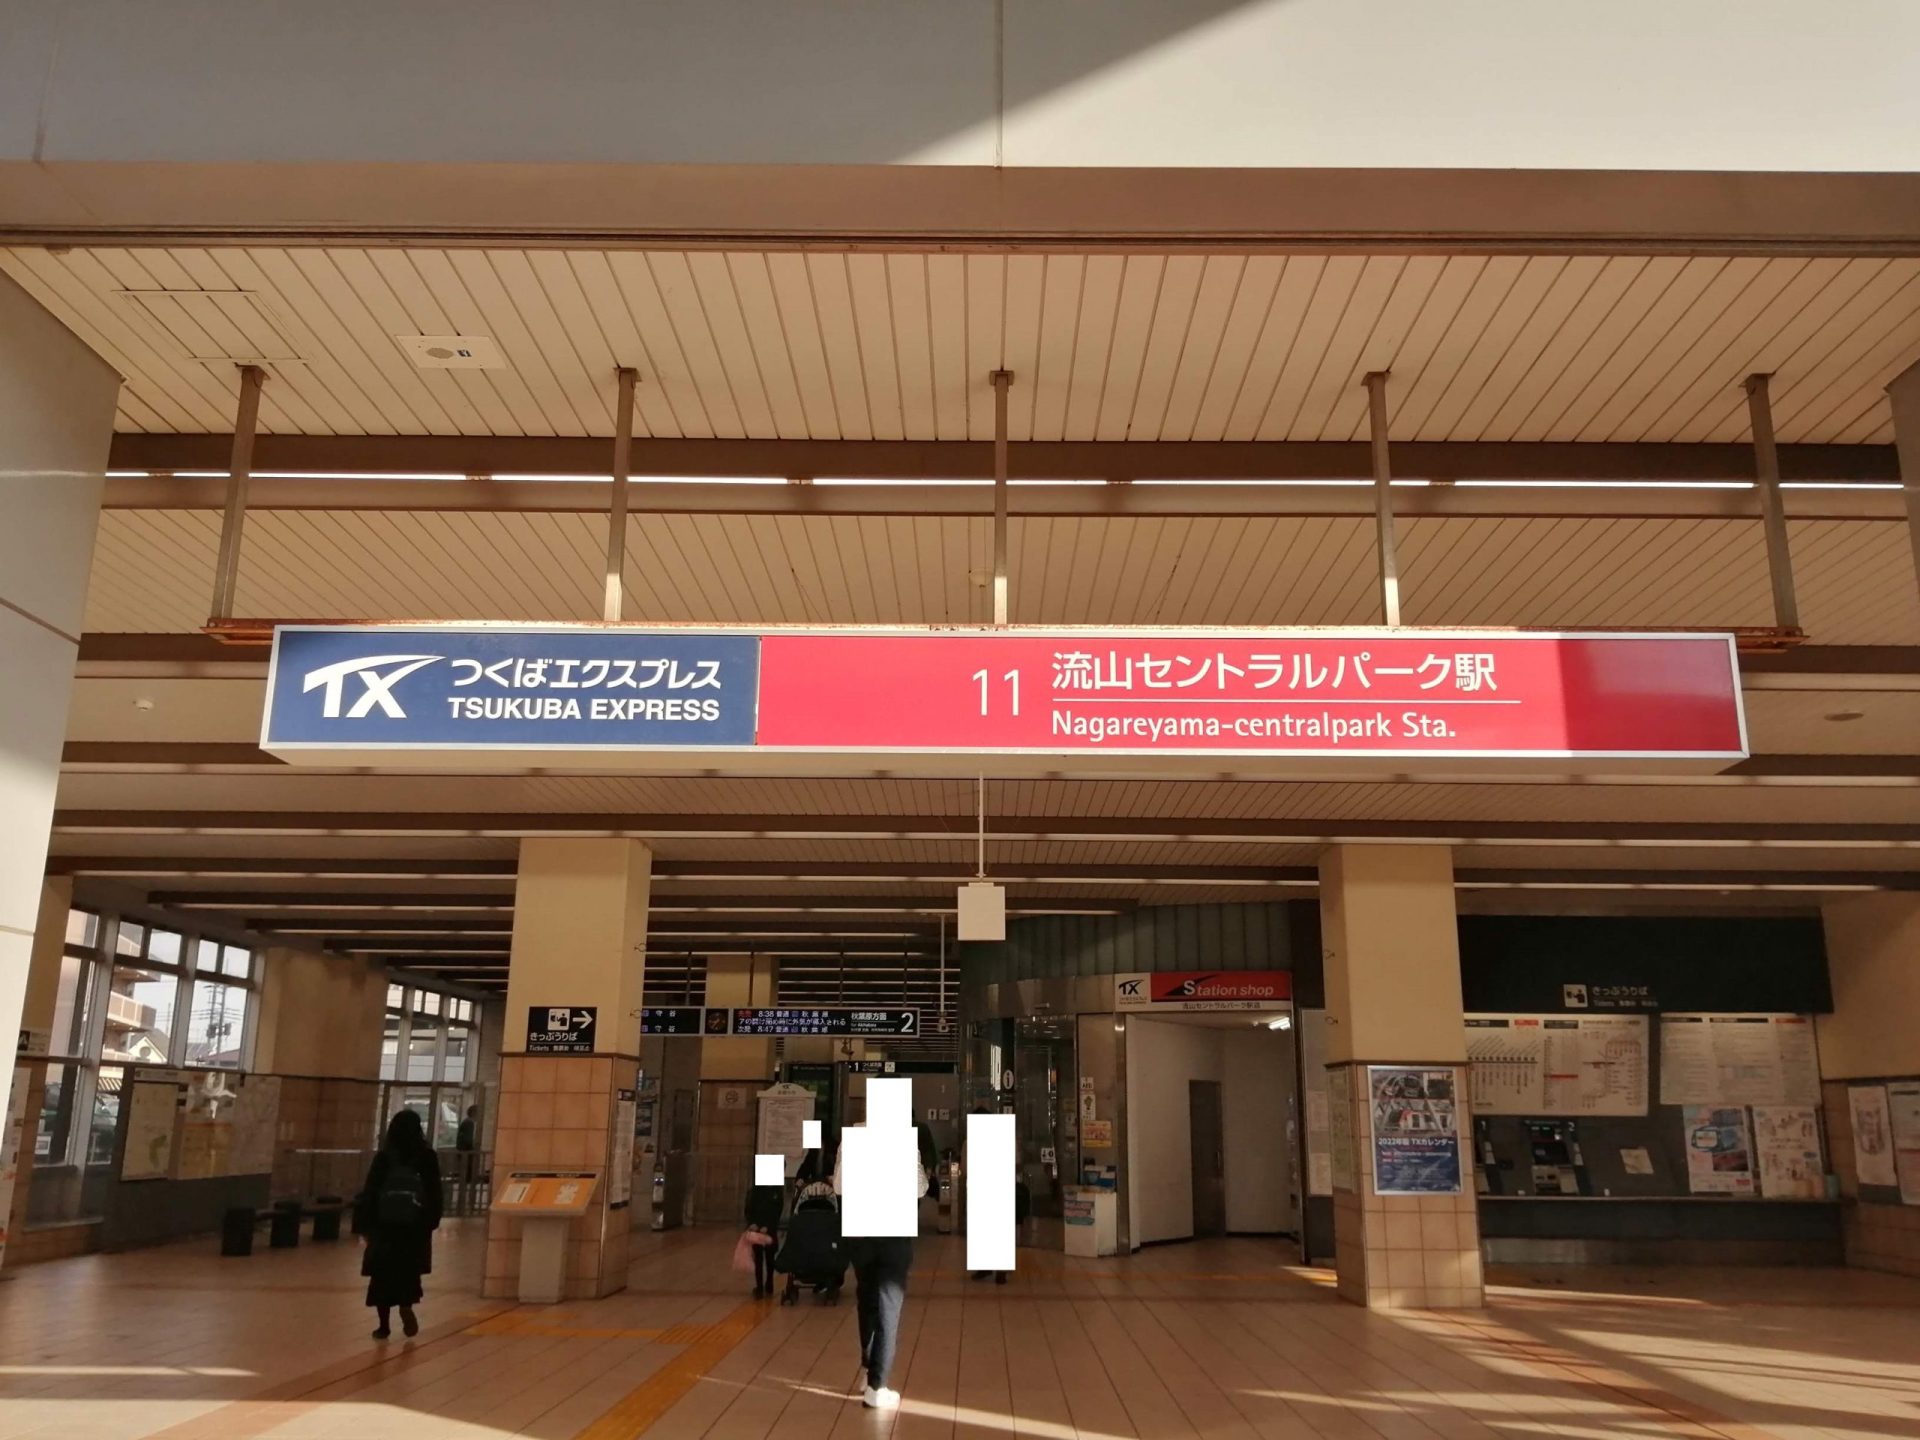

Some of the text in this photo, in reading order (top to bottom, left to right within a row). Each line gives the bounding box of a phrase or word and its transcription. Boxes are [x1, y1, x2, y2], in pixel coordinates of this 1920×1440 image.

[451, 657, 722, 690] つくばエクスプレス
[1052, 651, 1497, 693] 流山セントラルパーク駅
[302, 654, 447, 718] TX
[971, 668, 1021, 716] 11
[448, 697, 720, 722] TSUKUBA EXPRESS
[1052, 709, 1457, 743] Nagareyama-centralpark Sta.
[1118, 979, 1145, 995] TX
[1184, 980, 1275, 998] Station shop
[1592, 986, 1649, 996] きっぷうりば
[851, 1012, 887, 1021] 秋葉原方面
[900, 1012, 914, 1033] 2
[529, 1032, 579, 1042] きっぷうりば
[1567, 1121, 1576, 1131] 2
